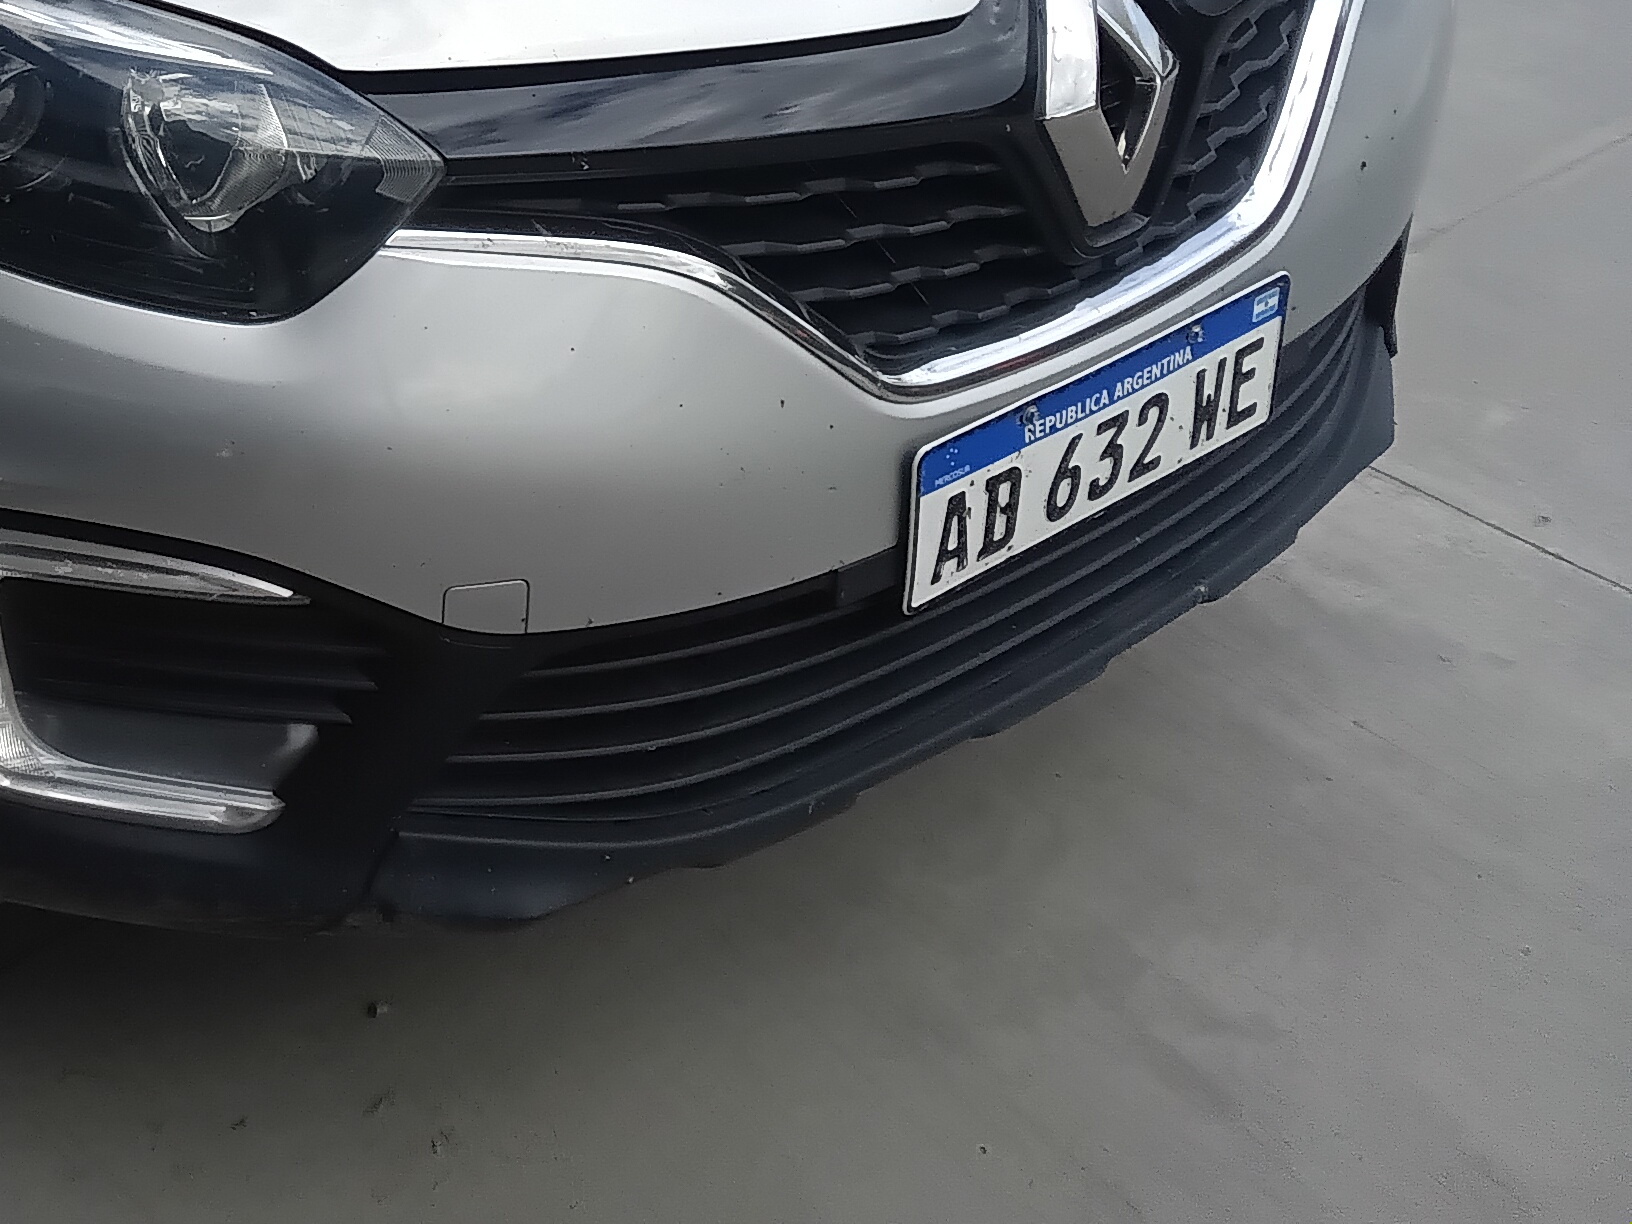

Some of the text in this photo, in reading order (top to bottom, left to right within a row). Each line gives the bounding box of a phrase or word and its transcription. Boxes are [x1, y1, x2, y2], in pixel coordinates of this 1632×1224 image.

[930, 336, 1265, 586] AB 632 WE
[1023, 345, 1194, 444] REPUBLICA ARGENTINA
